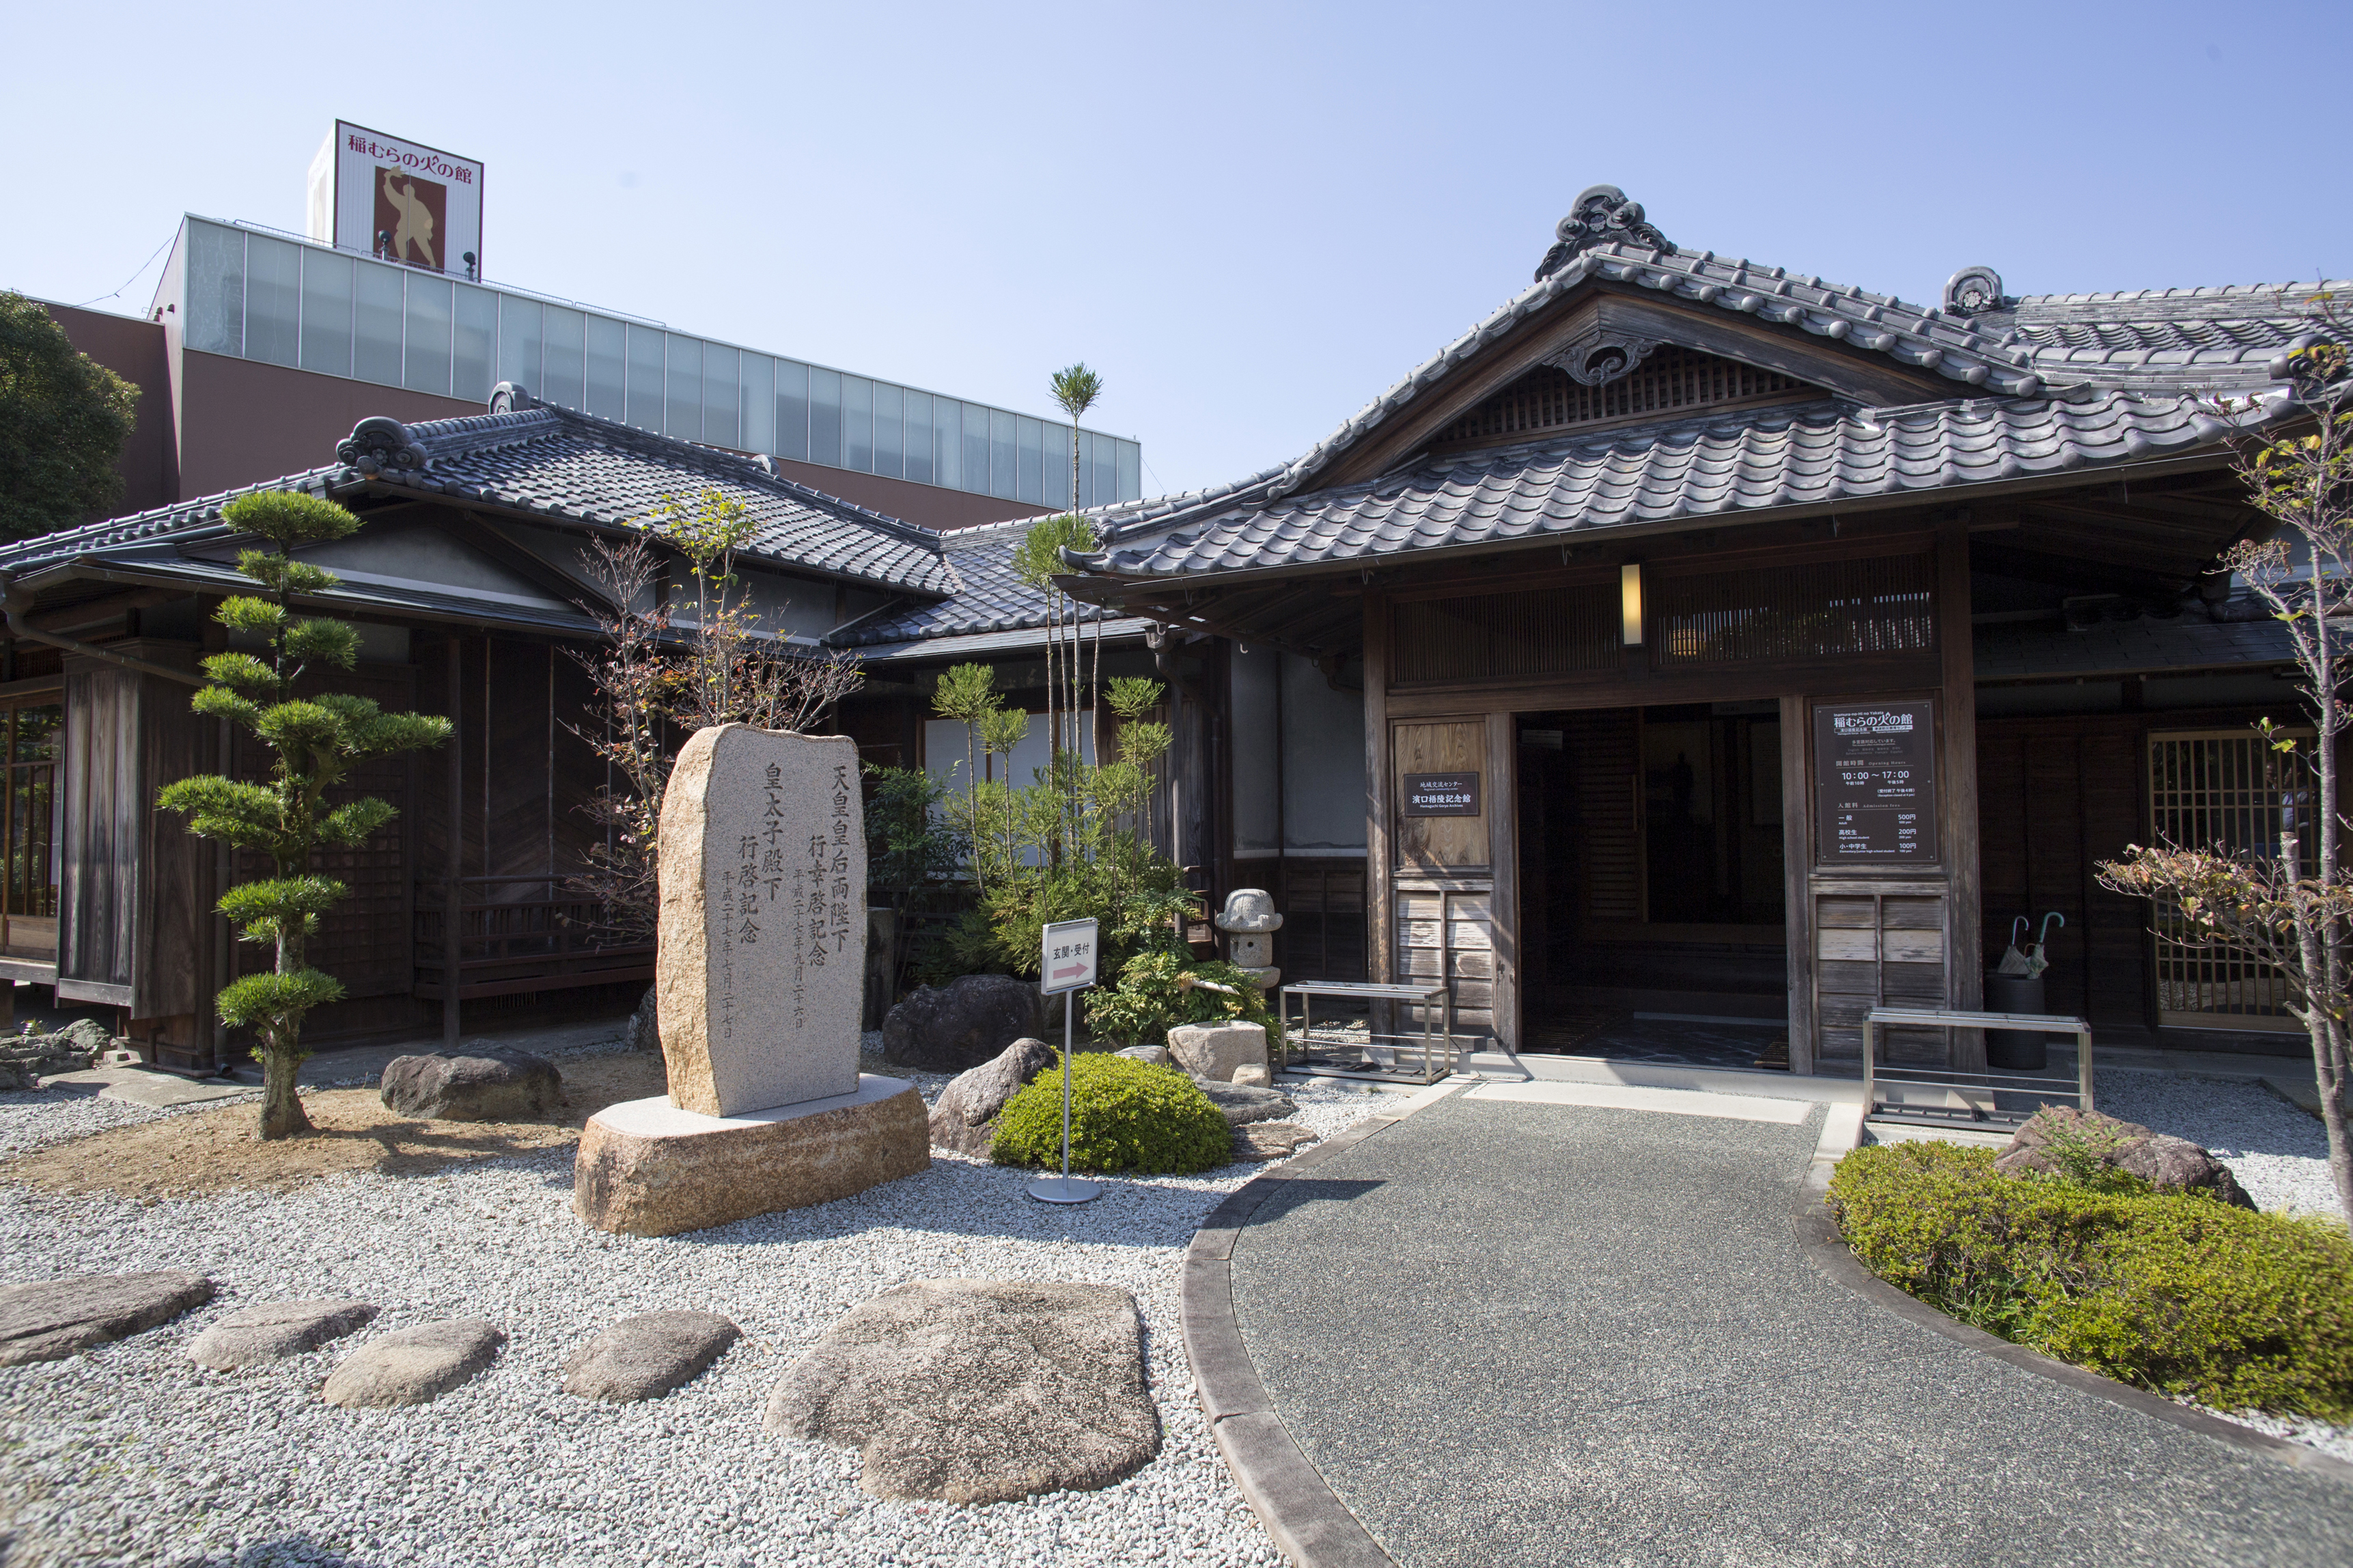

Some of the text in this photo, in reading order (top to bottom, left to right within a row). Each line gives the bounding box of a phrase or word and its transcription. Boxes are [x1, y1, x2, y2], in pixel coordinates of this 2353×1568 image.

[348, 135, 472, 184] 稲むらの火の館
[1834, 712, 1912, 728] 稲むらの火の館
[762, 762, 785, 901] 皇太子殿下
[830, 765, 850, 953] 天皇皇后両陛下
[1412, 794, 1471, 804] 濱口梧陵記念館
[738, 835, 760, 944] 行啓記念
[793, 869, 805, 1029] 平成二十七年九月二十六日
[807, 834, 828, 966] 行幸啓記念
[722, 871, 734, 1038] 平成二十七年七月二十七日
[1053, 942, 1090, 960] 玄関・受付
